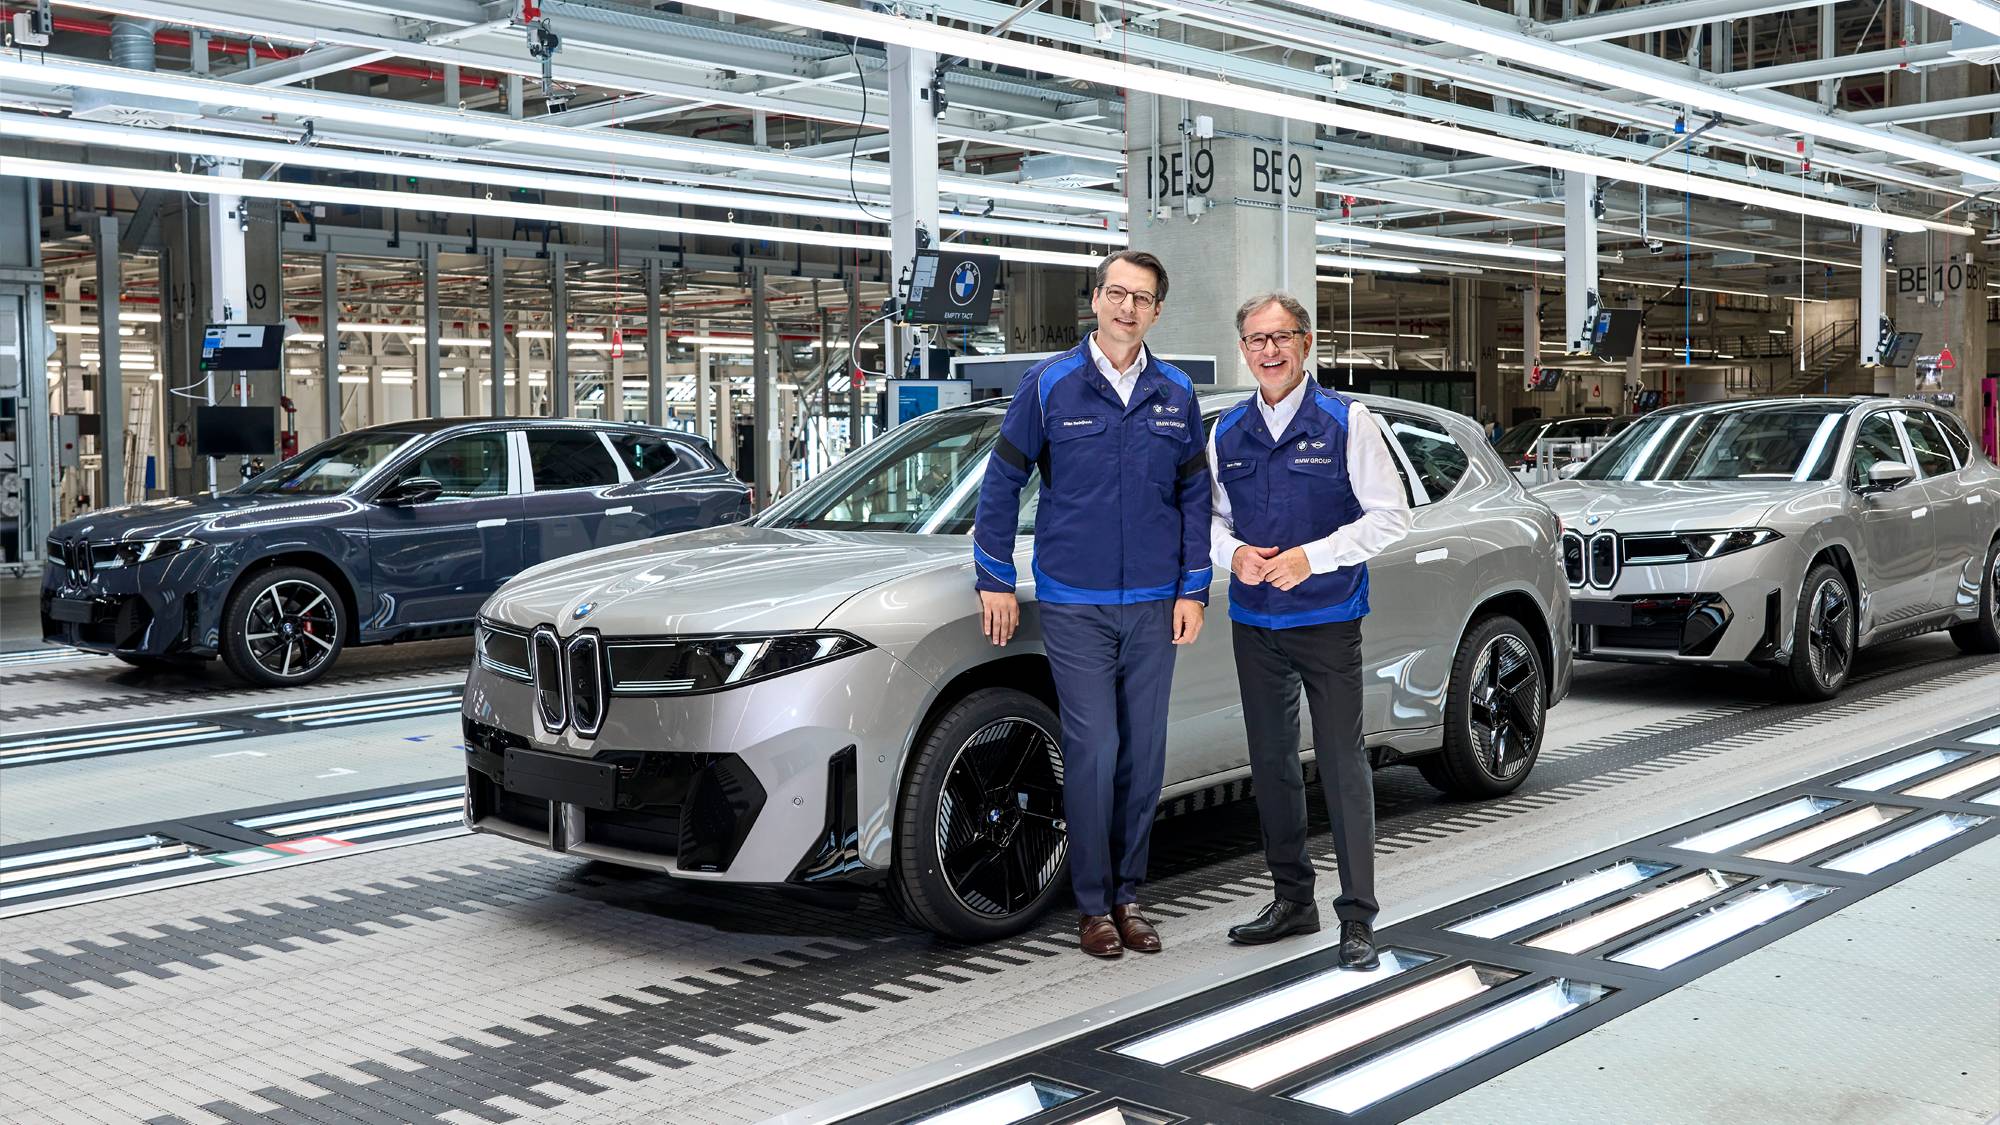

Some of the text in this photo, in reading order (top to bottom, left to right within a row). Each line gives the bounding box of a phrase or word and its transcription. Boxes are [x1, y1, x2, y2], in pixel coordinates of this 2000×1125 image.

[1147, 149, 1214, 199] BE9
[1253, 147, 1302, 197] BE9
[1899, 264, 1962, 292] BE10
[961, 312, 974, 320] TACT
[1170, 421, 1186, 429] GROUP
